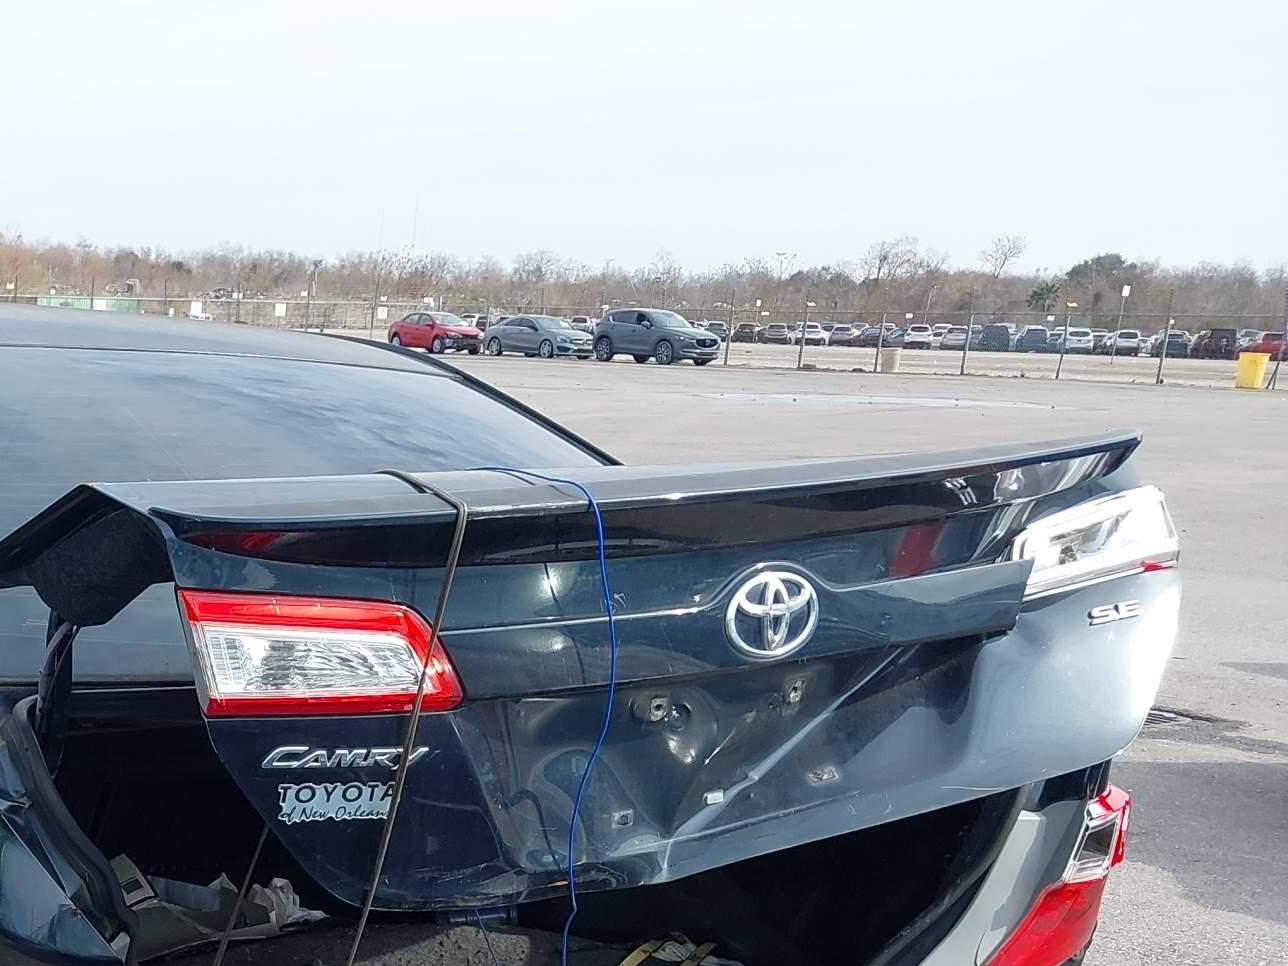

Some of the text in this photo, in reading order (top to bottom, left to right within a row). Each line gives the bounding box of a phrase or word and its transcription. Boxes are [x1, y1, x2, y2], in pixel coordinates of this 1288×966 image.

[1087, 599, 1142, 626] SE
[279, 784, 395, 804] TOYOTA
[280, 804, 389, 821] of New Orlean
